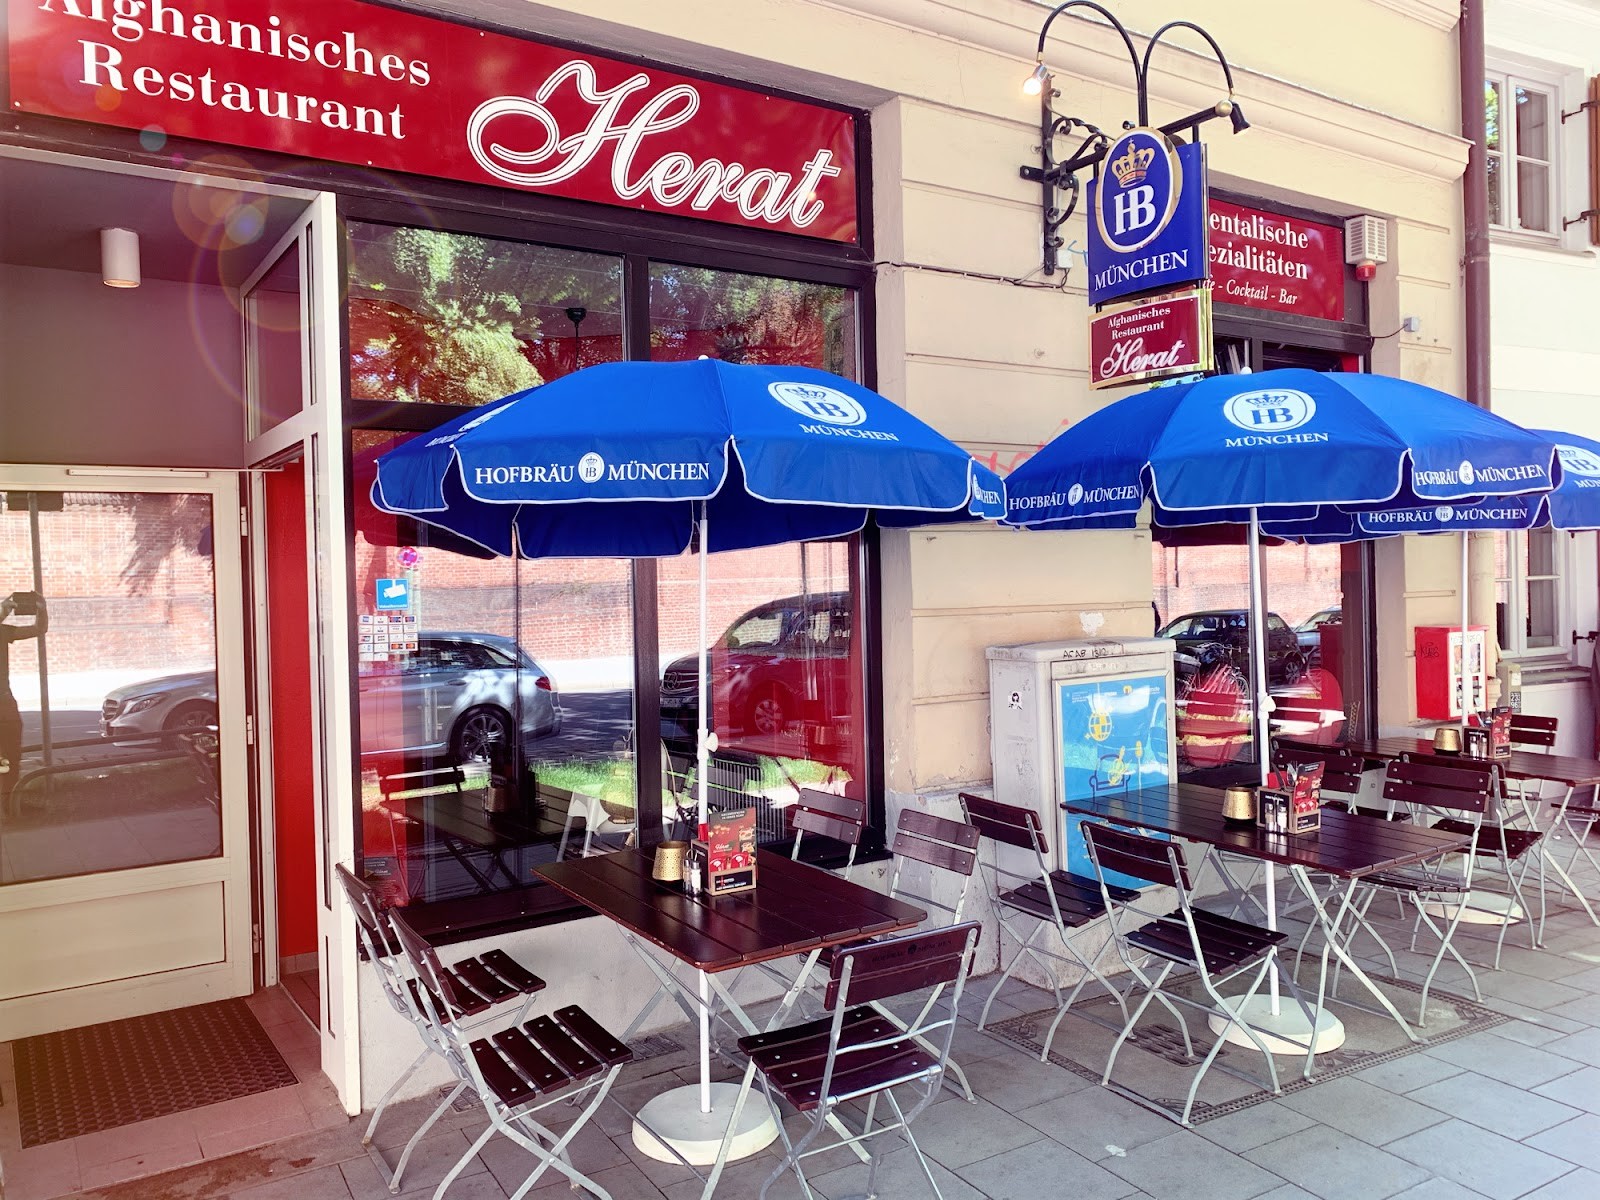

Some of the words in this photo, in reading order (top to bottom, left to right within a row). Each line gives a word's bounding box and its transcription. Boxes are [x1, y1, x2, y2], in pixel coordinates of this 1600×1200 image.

[78, 39, 406, 140] Restaurant
[467, 59, 841, 229] Herat
[1113, 184, 1157, 237] HB
[1209, 212, 1309, 249] entalische
[1094, 249, 1189, 292] MÜNCHEN
[1209, 241, 1309, 280] ezialitäten
[1226, 279, 1269, 301] Cocktail
[1279, 288, 1298, 305] Bar
[1108, 307, 1171, 328] Afghanisches
[1111, 320, 1165, 340] Restaurant
[1100, 337, 1186, 379] Herat
[1250, 407, 1294, 425] HB
[798, 423, 900, 442] MÜNCHEN
[1225, 432, 1329, 448] MÜNCHEN
[475, 463, 575, 484] HOFBRÄU
[607, 460, 710, 481] MÜNCHEN
[1414, 469, 1458, 487] HOFBRÄU
[1475, 464, 1546, 483] MÜNCHEN
[1009, 492, 1067, 511] HOFBRÄU
[1083, 484, 1140, 504] MÜNCHEN
[1368, 509, 1433, 523] HOFBRÄU
[1455, 507, 1528, 521] MÜNCHEN
